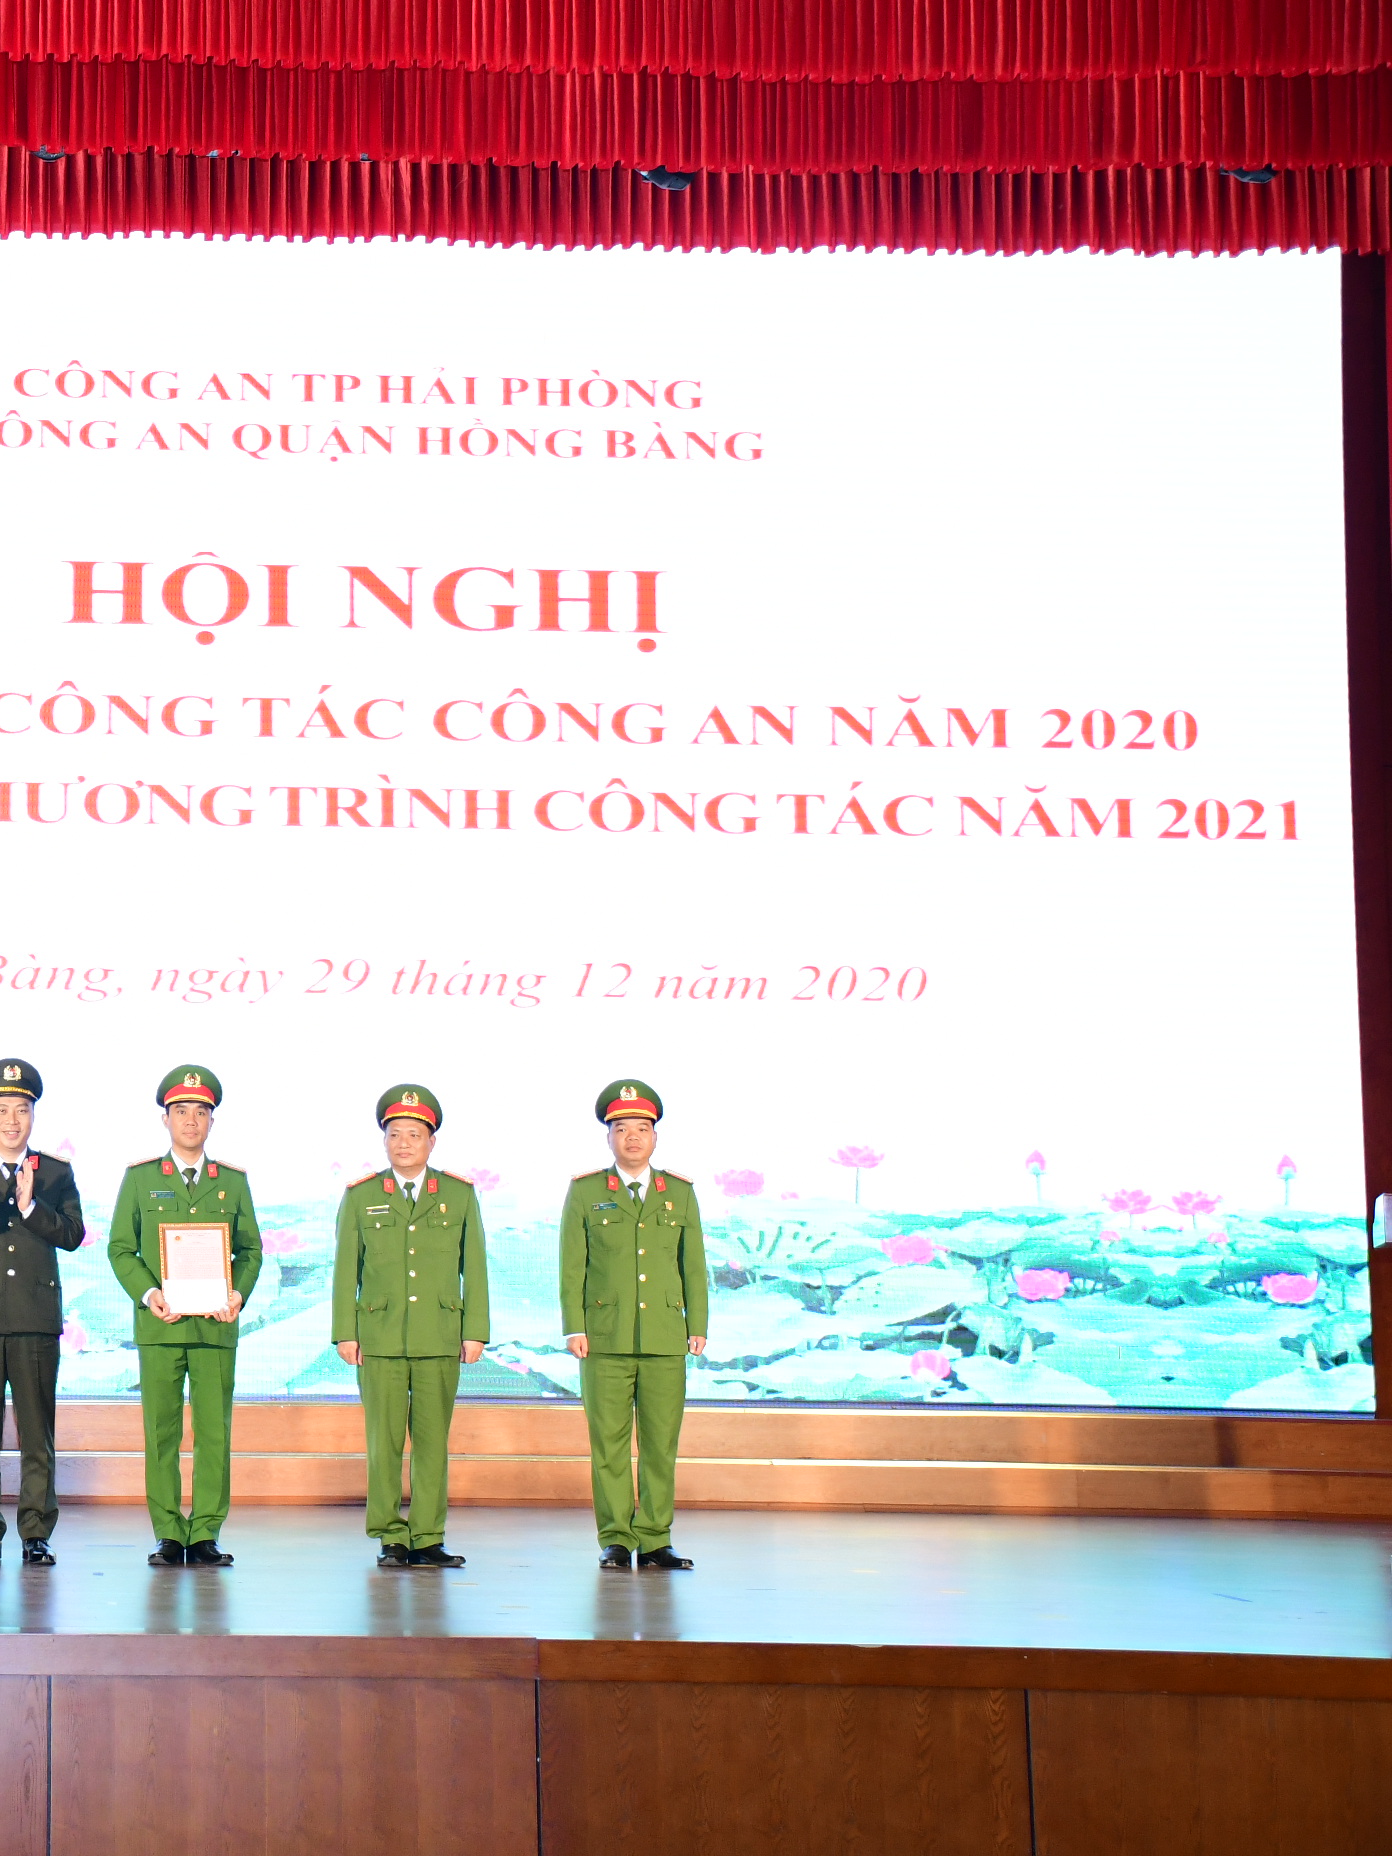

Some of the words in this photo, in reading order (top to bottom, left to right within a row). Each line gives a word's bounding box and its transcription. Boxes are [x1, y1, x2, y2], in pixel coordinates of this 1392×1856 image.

[14, 360, 180, 400] CÔNG
[198, 373, 273, 400] AN
[292, 374, 361, 402] TP
[377, 367, 478, 405] HẢI
[501, 370, 702, 409] PHÒNG
[136, 423, 211, 450] AN
[232, 420, 394, 462] QUẬN
[417, 419, 582, 458] HỒNG
[605, 422, 763, 461] BÀNG
[62, 552, 298, 645] HỘI
[338, 566, 667, 653] NGHỊ
[242, 685, 404, 740] TÁC
[433, 688, 666, 744] CÔNG
[691, 705, 798, 745] AN
[829, 695, 1009, 748] NĂM
[1041, 709, 1198, 751] 2020
[270, 774, 513, 829] TRÌNH
[534, 778, 761, 834] CÔNG
[776, 781, 934, 836] TÁC
[955, 785, 1134, 838] NĂM
[1157, 799, 1299, 840] 2021
[151, 957, 283, 1003] ngày
[305, 959, 370, 993] 29
[392, 960, 546, 1007] tháng
[575, 963, 632, 997] 12
[655, 965, 767, 1000] năm
[792, 966, 927, 1001] 2020
